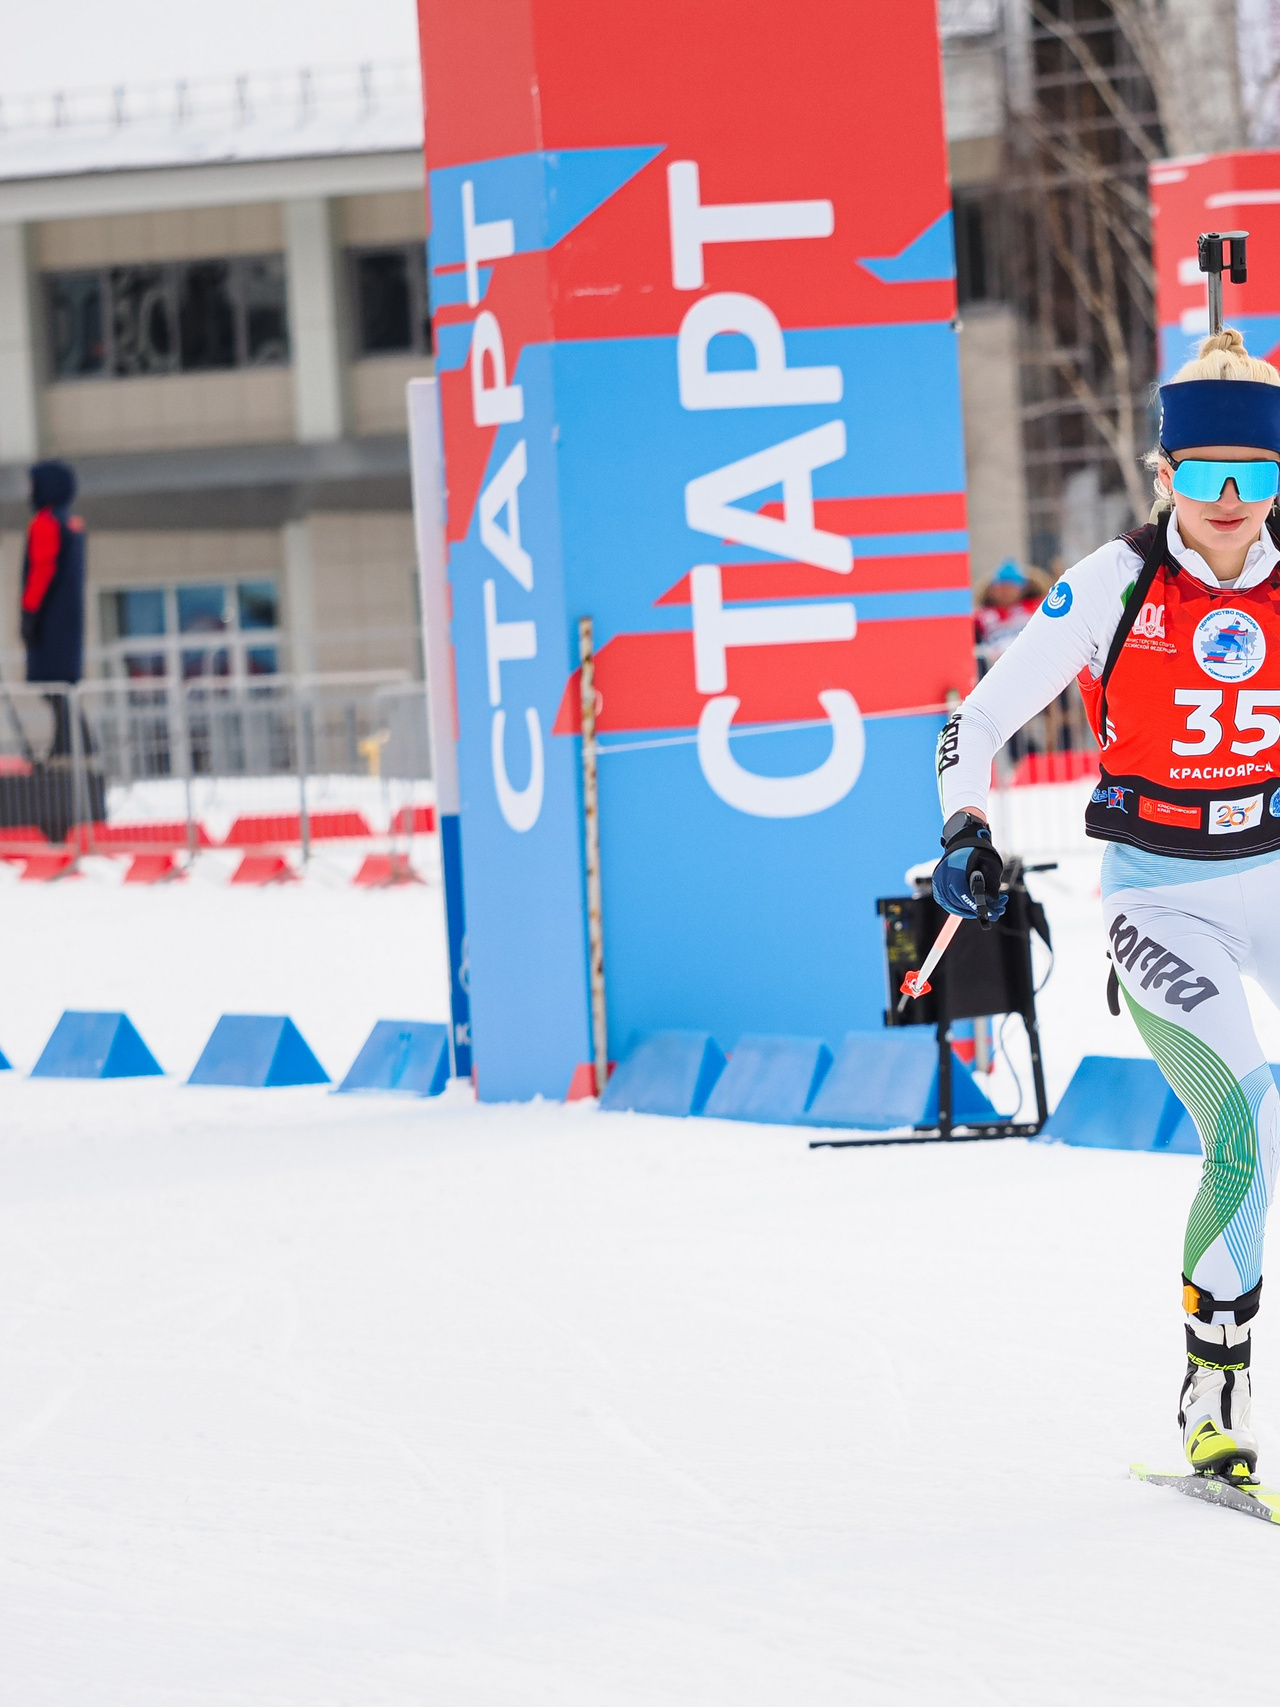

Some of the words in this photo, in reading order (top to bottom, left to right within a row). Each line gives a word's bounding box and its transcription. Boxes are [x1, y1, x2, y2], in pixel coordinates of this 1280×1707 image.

[461, 179, 544, 833] СТАРТ
[667, 159, 866, 818] СТАРТ
[1198, 610, 1234, 631] ПЕРВЕНСТВО
[1236, 611, 1259, 631] РОССИИ
[1187, 1351, 1245, 1371] FISCHER
